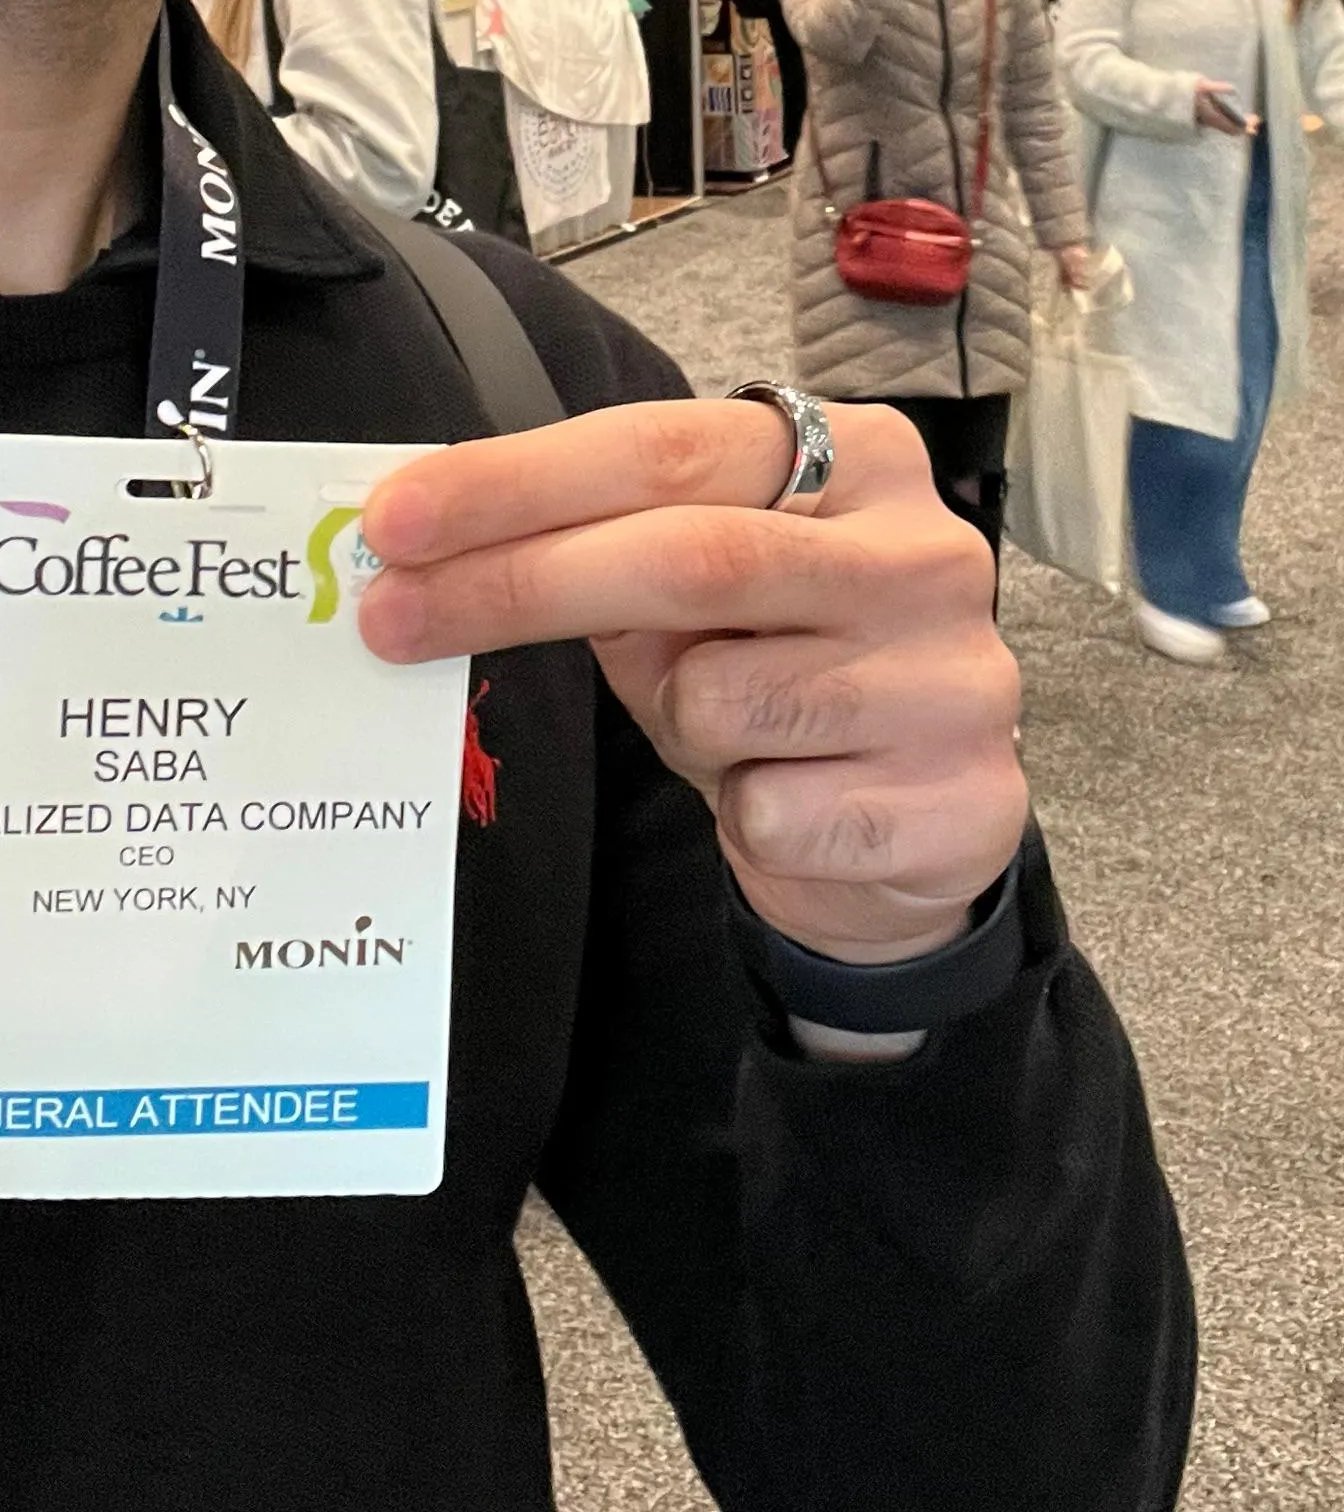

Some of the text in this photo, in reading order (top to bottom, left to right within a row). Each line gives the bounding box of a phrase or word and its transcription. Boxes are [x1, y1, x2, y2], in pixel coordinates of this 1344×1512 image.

[59, 697, 248, 739] HENRY
[94, 750, 208, 783] SABA
[126, 803, 228, 833] DATA
[240, 801, 432, 832] COMPANY
[119, 845, 175, 867] CEO
[32, 885, 257, 914] NEW YORK, NY
[234, 914, 405, 970] MONIN
[130, 1089, 359, 1128] ATTENDEE
